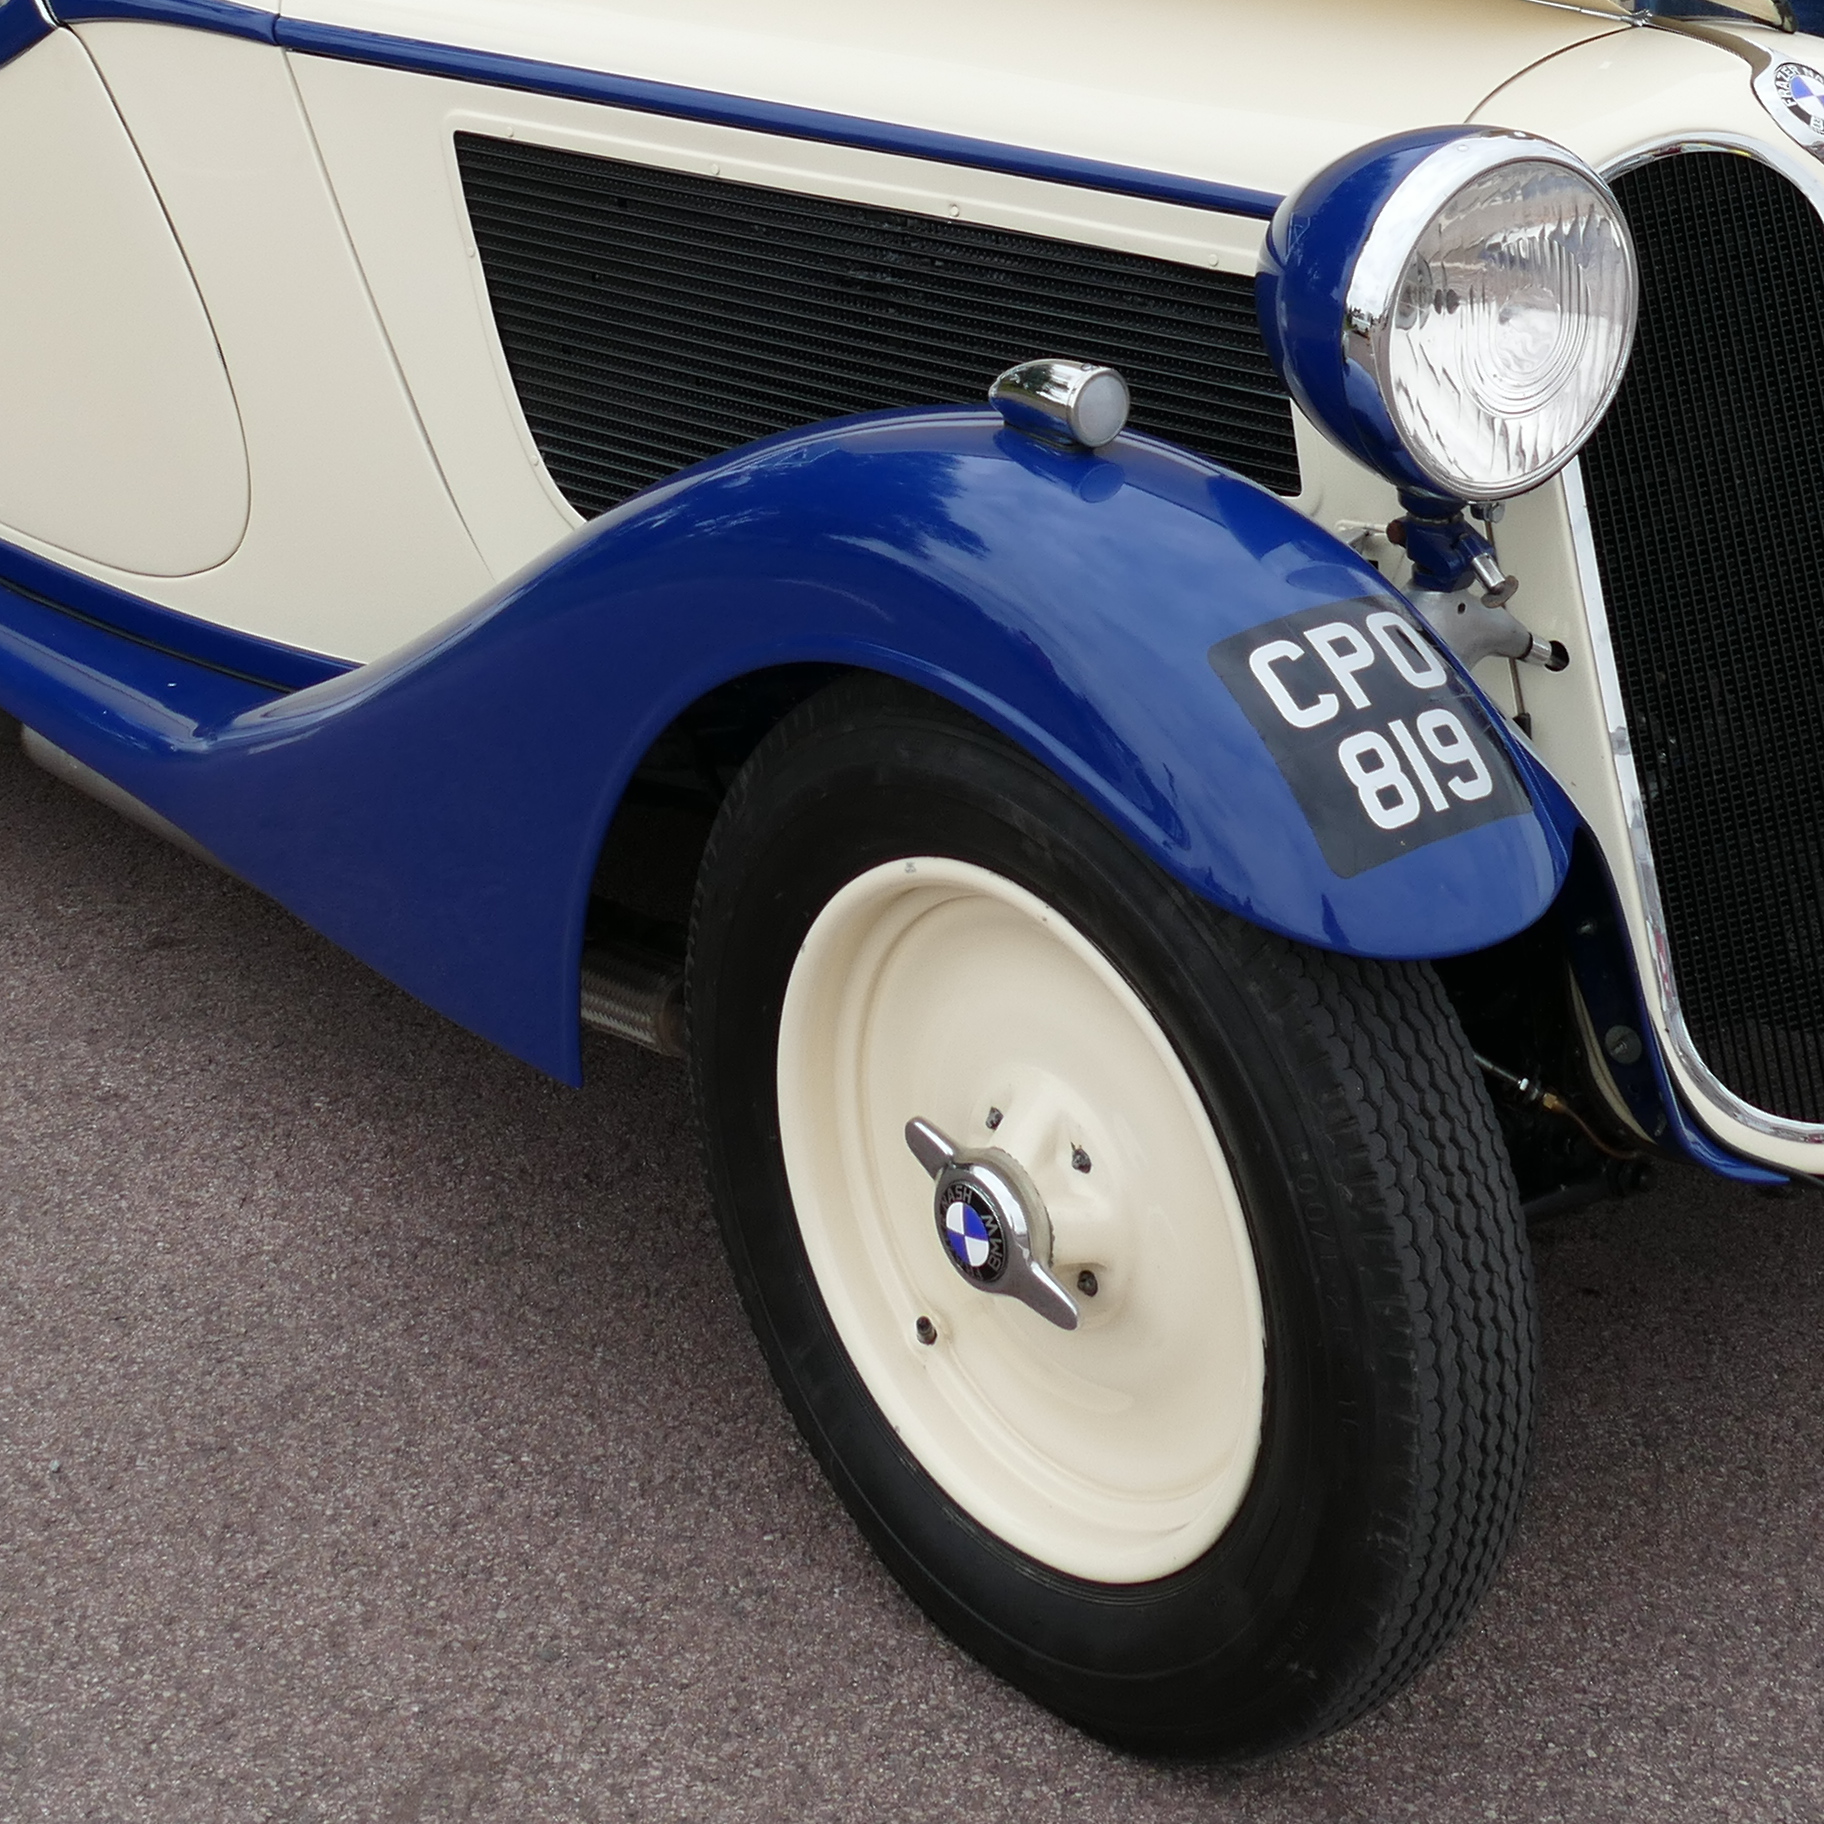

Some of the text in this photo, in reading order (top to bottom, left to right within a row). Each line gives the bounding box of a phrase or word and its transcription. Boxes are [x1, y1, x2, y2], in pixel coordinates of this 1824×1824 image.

[1775, 65, 1801, 107] FRAZER
[1248, 610, 1448, 729] CPO
[1337, 708, 1493, 830] 819
[941, 1185, 973, 1210] NASH
[981, 1214, 1003, 1272] BMW
